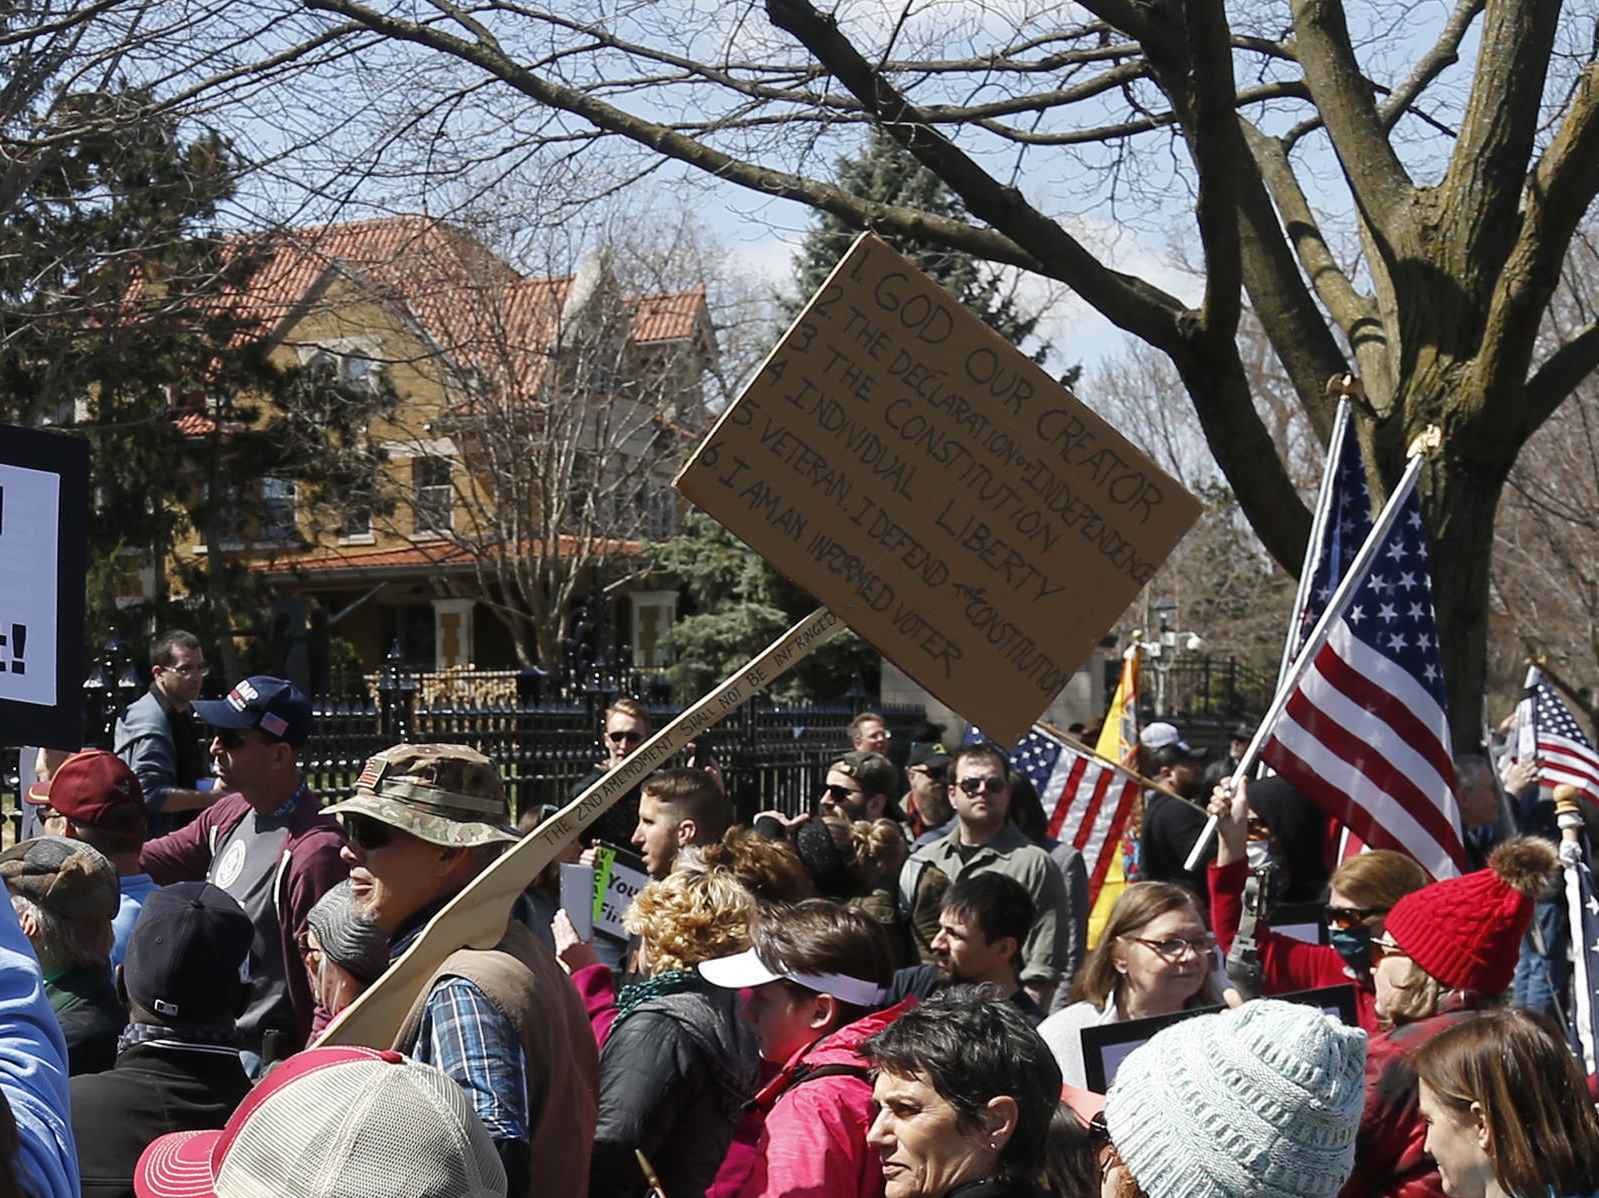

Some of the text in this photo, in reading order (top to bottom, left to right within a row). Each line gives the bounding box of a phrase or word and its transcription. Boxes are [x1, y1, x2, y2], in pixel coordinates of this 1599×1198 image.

[782, 374, 917, 502] INDIVIDUAL
[933, 497, 1067, 603] LIBERTY
[786, 320, 1071, 556] 3. THE CONSTITUTION
[812, 283, 844, 321] 2.
[841, 304, 893, 362] THE
[888, 350, 1017, 467] DECLARATION
[1019, 457, 1157, 587] INDEPENDENCE
[848, 247, 1164, 526] 1. GOD OUR CREATOR
[716, 454, 751, 489] I
[803, 529, 895, 613] INFORMED
[890, 601, 963, 680] VOTER
[848, 494, 877, 527] I
[865, 508, 950, 588] DEFEND
[963, 598, 1069, 700] CONSTITUTION
[538, 611, 838, 847] THE 2ND AMENDMENT SHALL NOT BE INFRINGED
